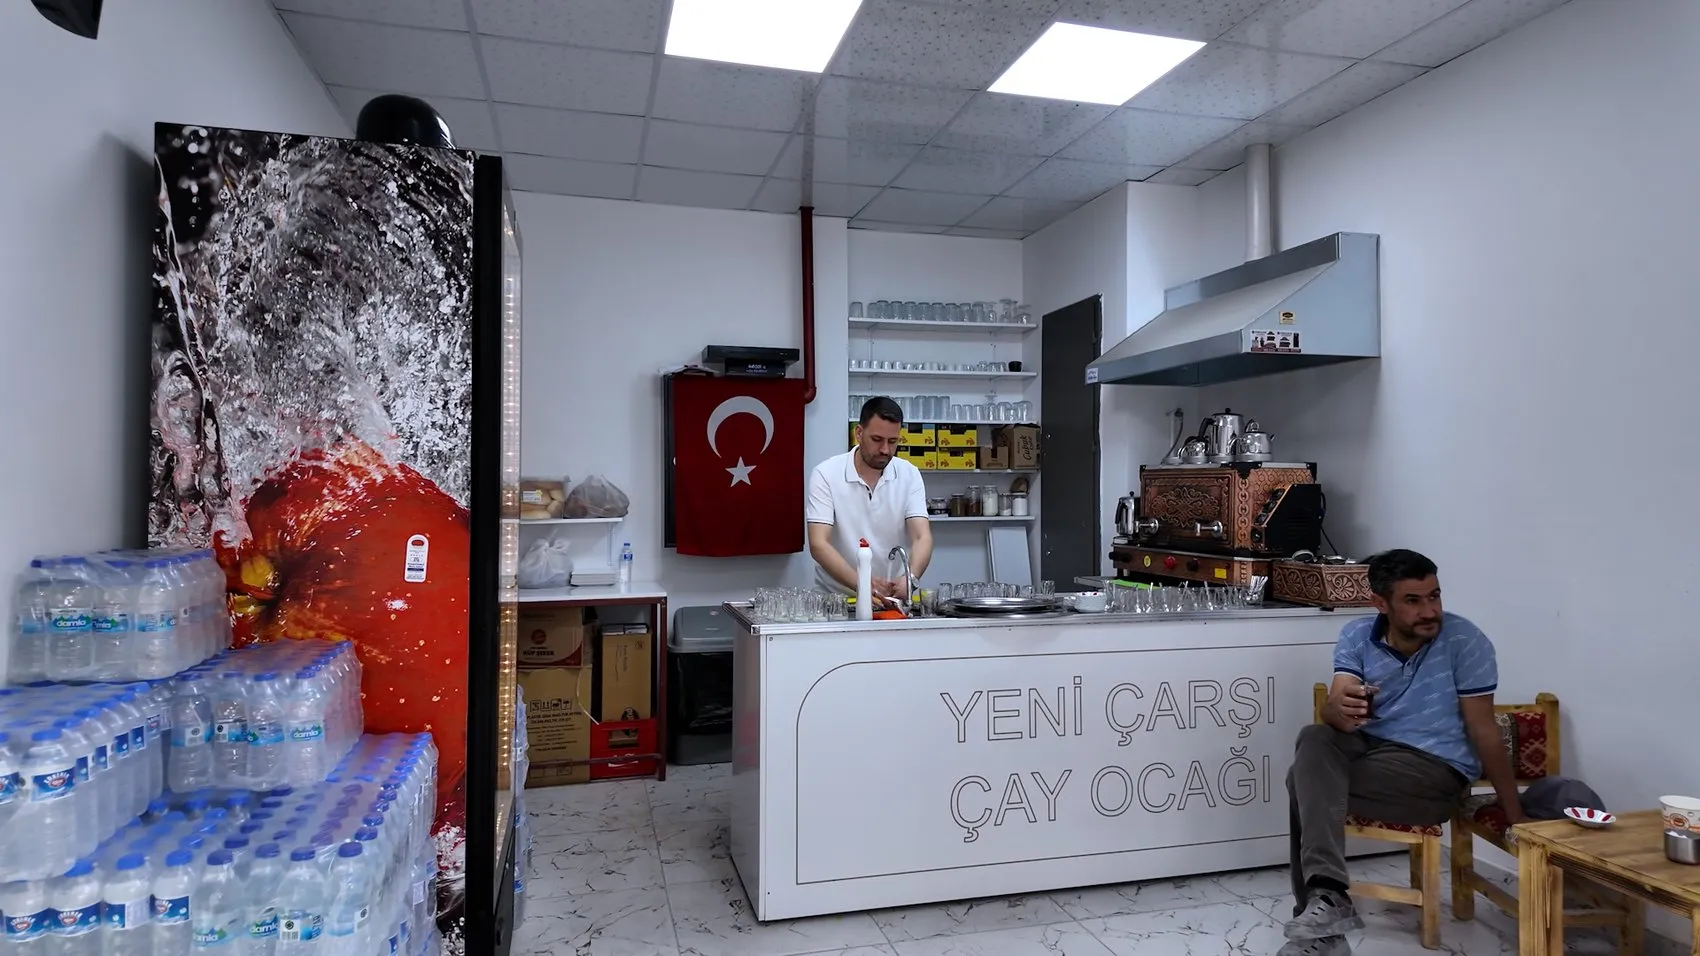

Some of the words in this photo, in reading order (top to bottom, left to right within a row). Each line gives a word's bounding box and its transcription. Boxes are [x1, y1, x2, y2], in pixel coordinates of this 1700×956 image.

[56, 619, 86, 627] damla
[940, 676, 1083, 743] YENİ
[1105, 677, 1275, 746] ÇARŞI
[950, 769, 1072, 842] ÇAY
[1090, 746, 1270, 817] OCAĞI
